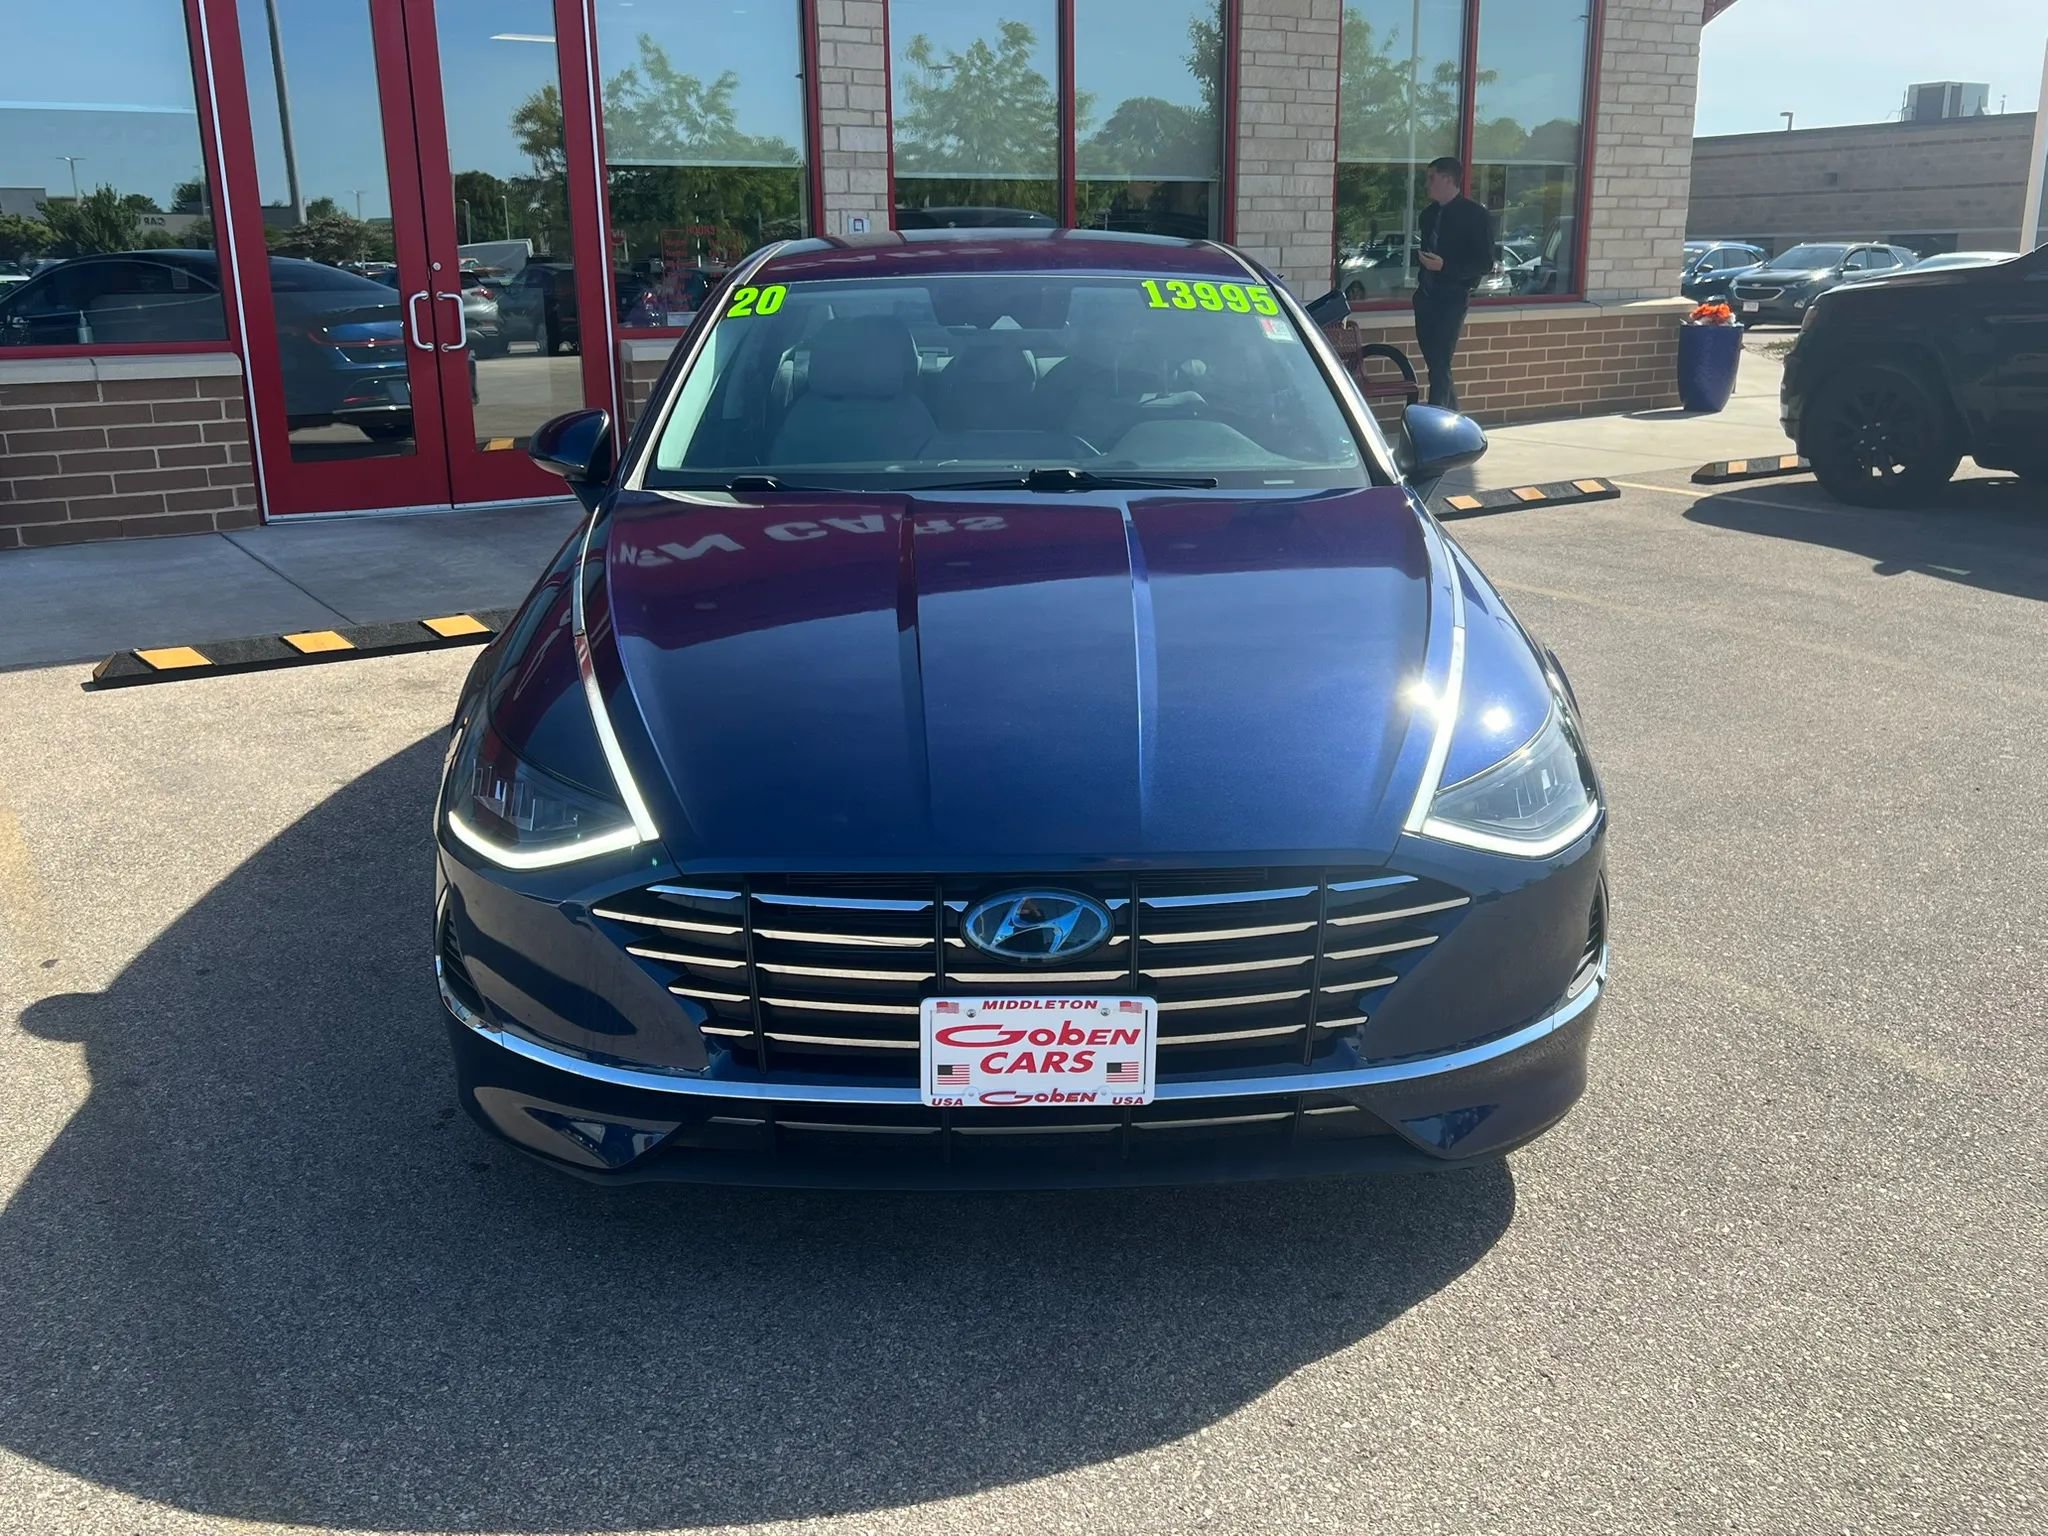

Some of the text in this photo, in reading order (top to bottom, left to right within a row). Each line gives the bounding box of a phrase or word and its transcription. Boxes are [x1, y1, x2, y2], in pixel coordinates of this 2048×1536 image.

[727, 284, 787, 318] 20
[1141, 279, 1279, 317] 13995
[982, 999, 1098, 1010] MIDDLETON
[979, 1050, 1096, 1075] CARS
[931, 1097, 964, 1107] USA
[1112, 1096, 1144, 1106] USA
